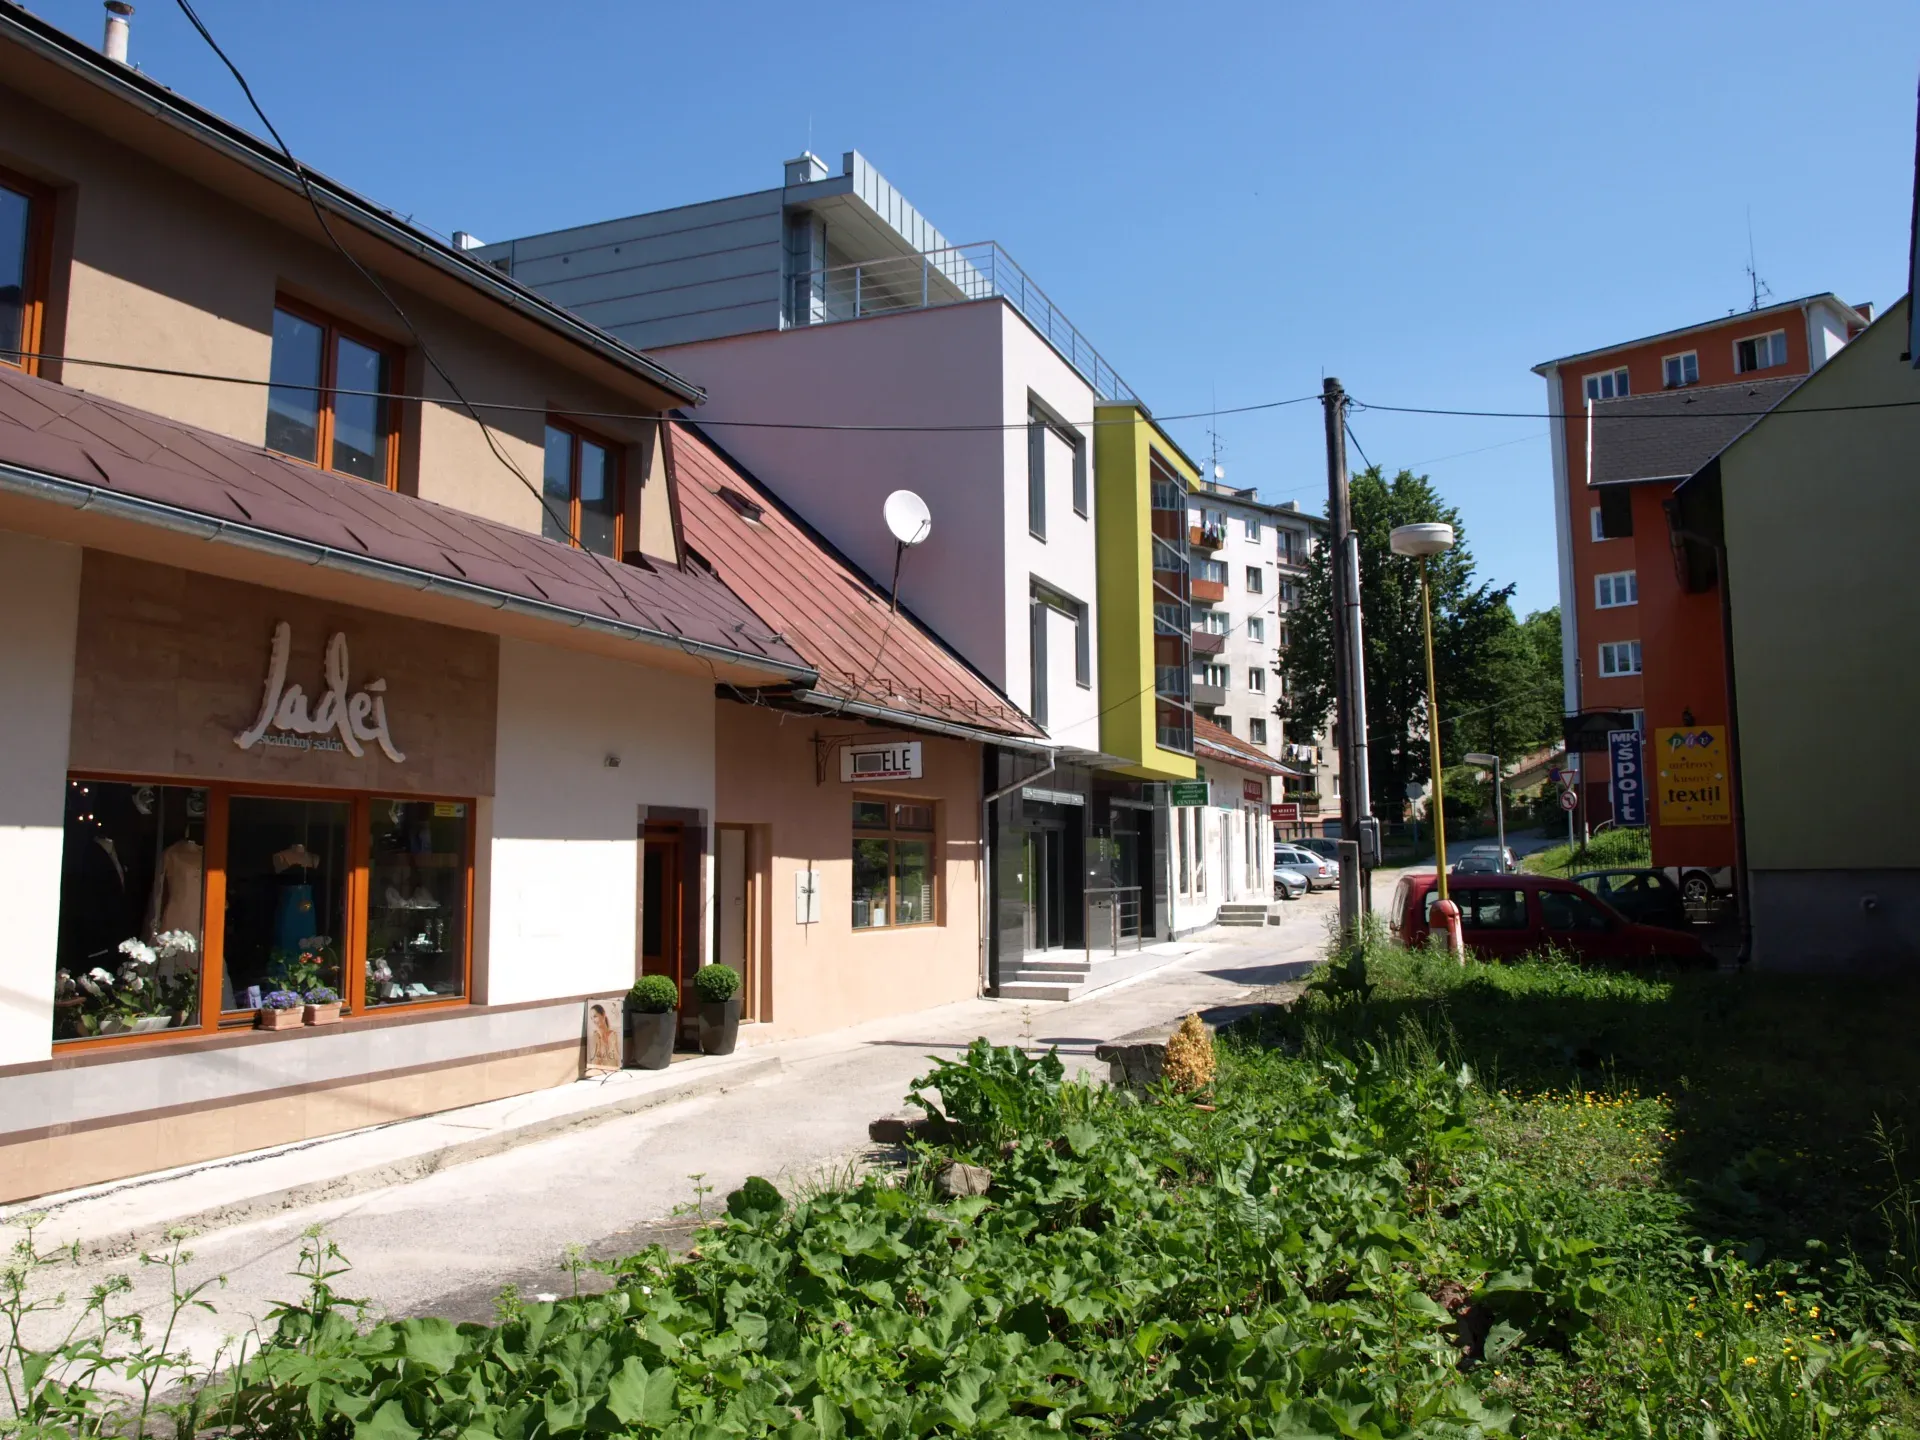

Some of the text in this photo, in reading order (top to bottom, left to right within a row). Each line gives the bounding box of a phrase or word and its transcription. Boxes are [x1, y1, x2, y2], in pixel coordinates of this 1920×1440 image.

[1611, 733, 1638, 743] MK
[850, 749, 911, 773] TELE
[1668, 785, 1721, 803] textil
